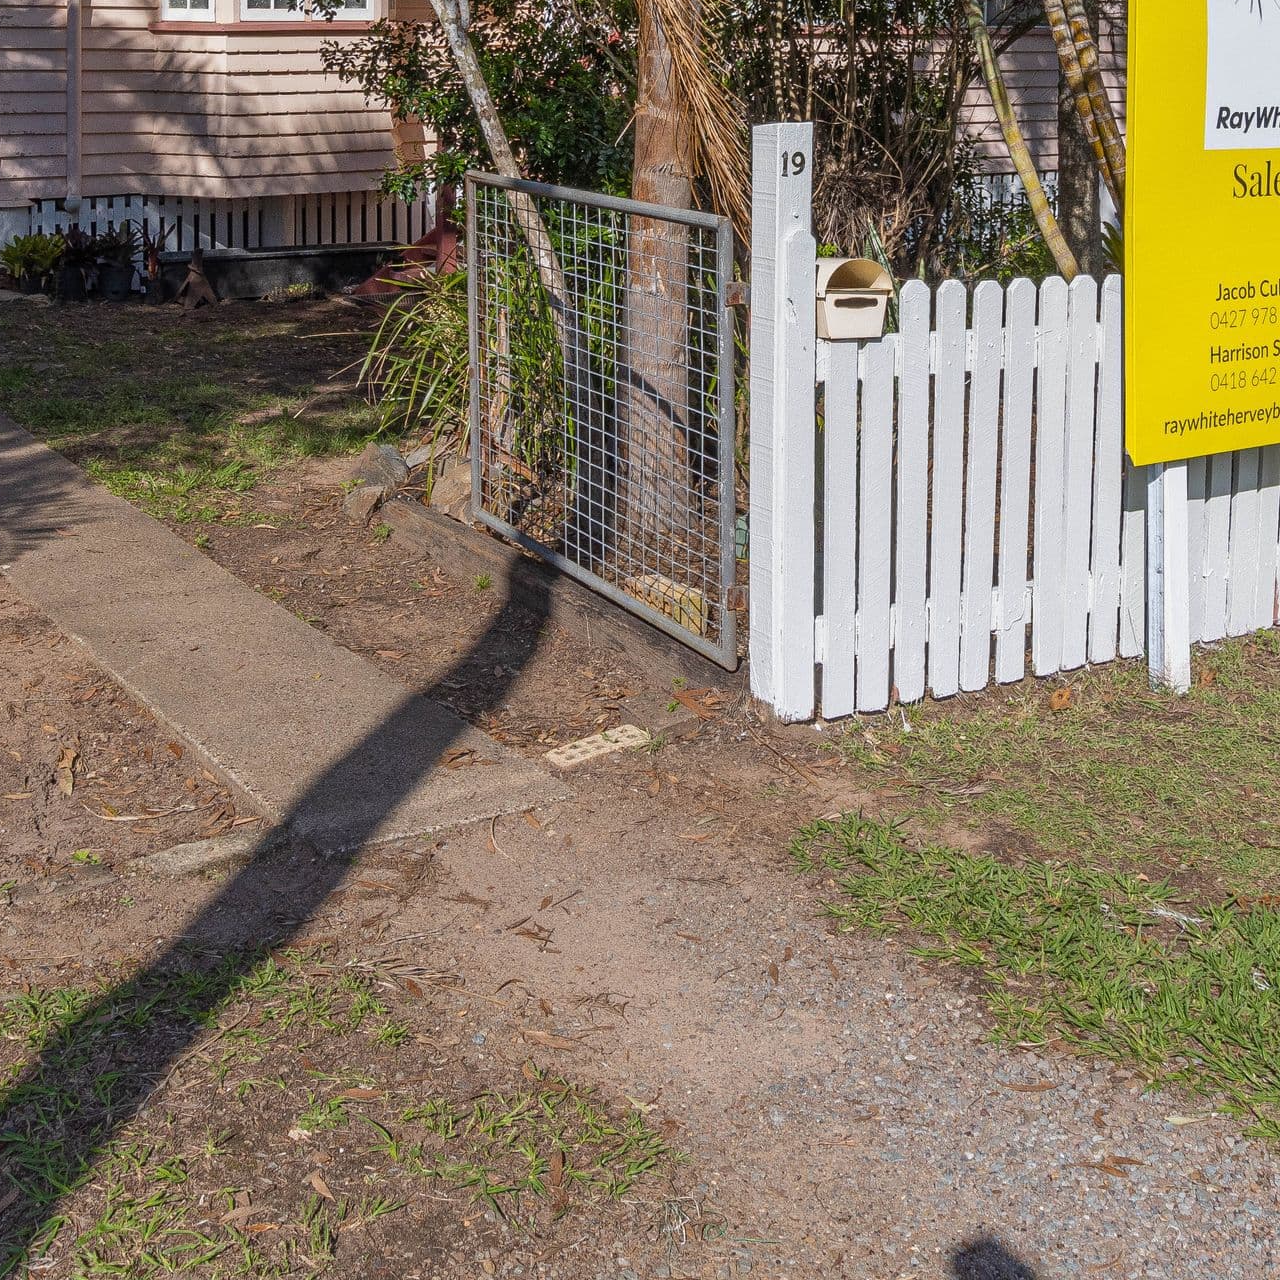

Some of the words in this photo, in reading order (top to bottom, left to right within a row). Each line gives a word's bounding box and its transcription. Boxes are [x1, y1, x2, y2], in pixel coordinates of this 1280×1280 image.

[781, 150, 806, 177] 19
[1216, 281, 1256, 301] Jacob
[1210, 309, 1247, 329] 0427
[1251, 306, 1277, 325] 978
[1210, 343, 1269, 364] Harrison
[1210, 370, 1247, 391] 0418
[1251, 367, 1277, 387] 642
